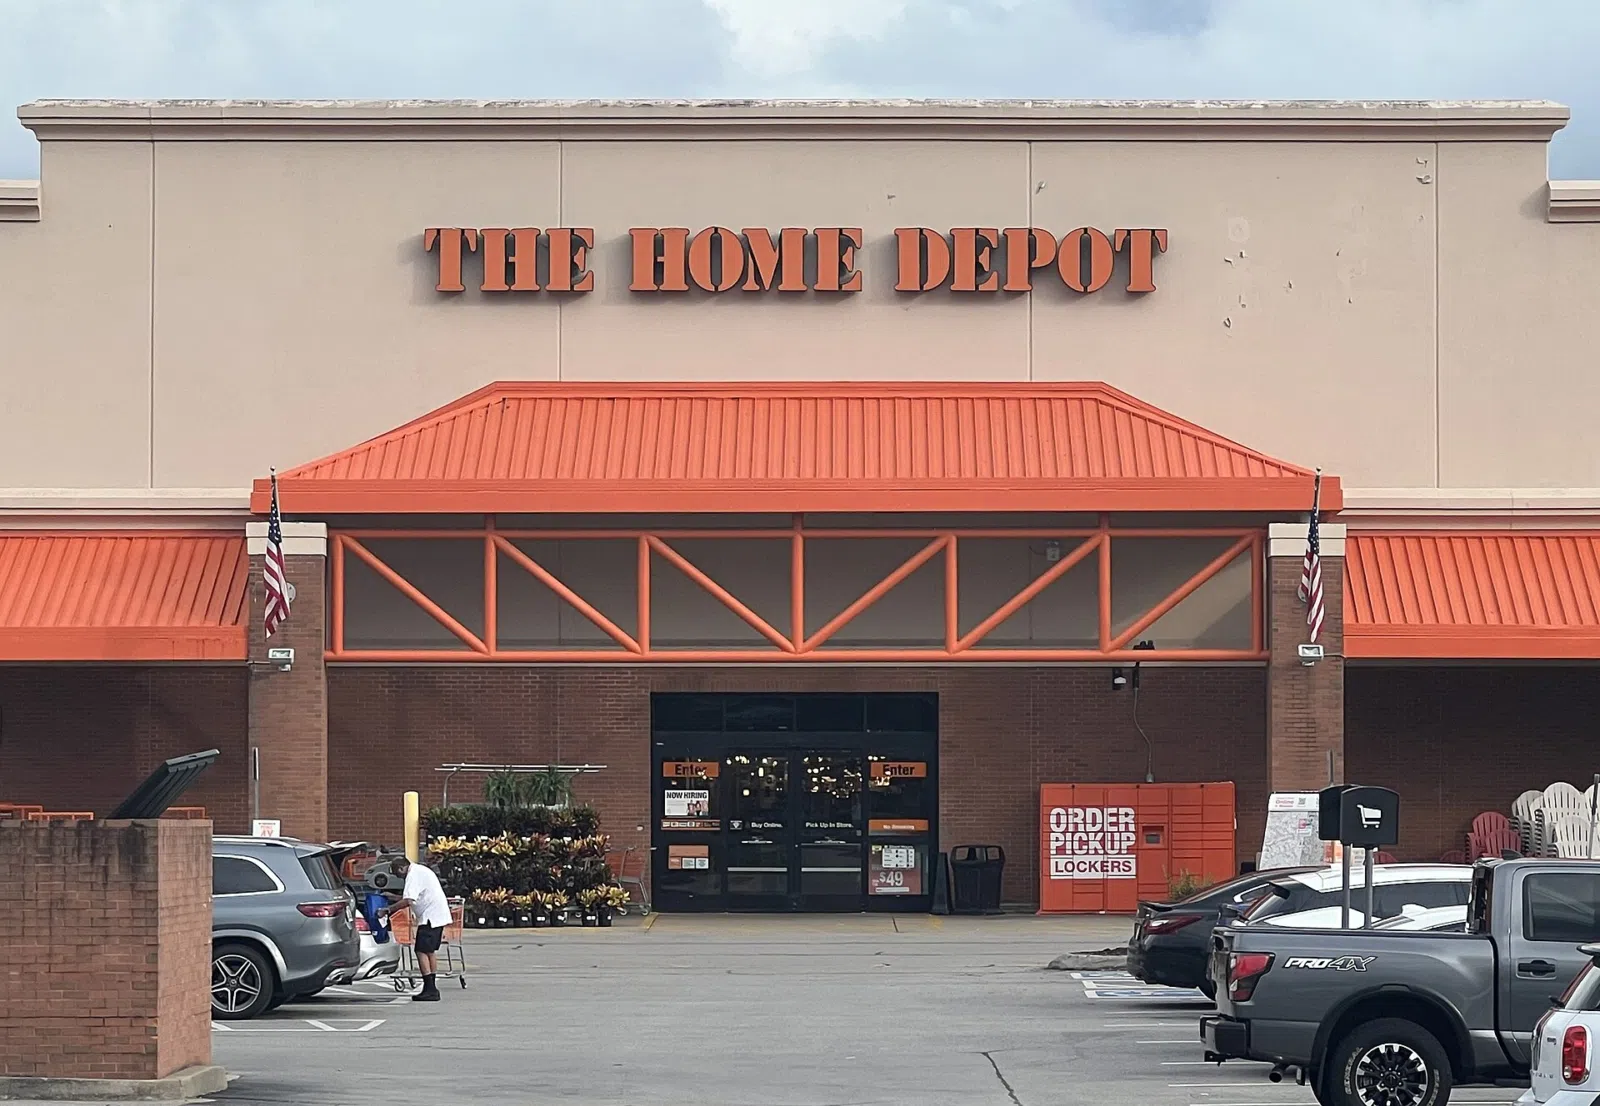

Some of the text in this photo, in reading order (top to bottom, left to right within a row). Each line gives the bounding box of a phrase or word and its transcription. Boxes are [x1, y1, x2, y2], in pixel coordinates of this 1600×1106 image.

[424, 227, 1167, 293] THE HOME DEPOT
[675, 764, 707, 775] Enter
[883, 764, 915, 775] Enter
[1050, 807, 1136, 832] ORDER
[1050, 832, 1136, 855] PICKUP
[1055, 860, 1132, 873] LOCKERS
[879, 871, 904, 886] $49
